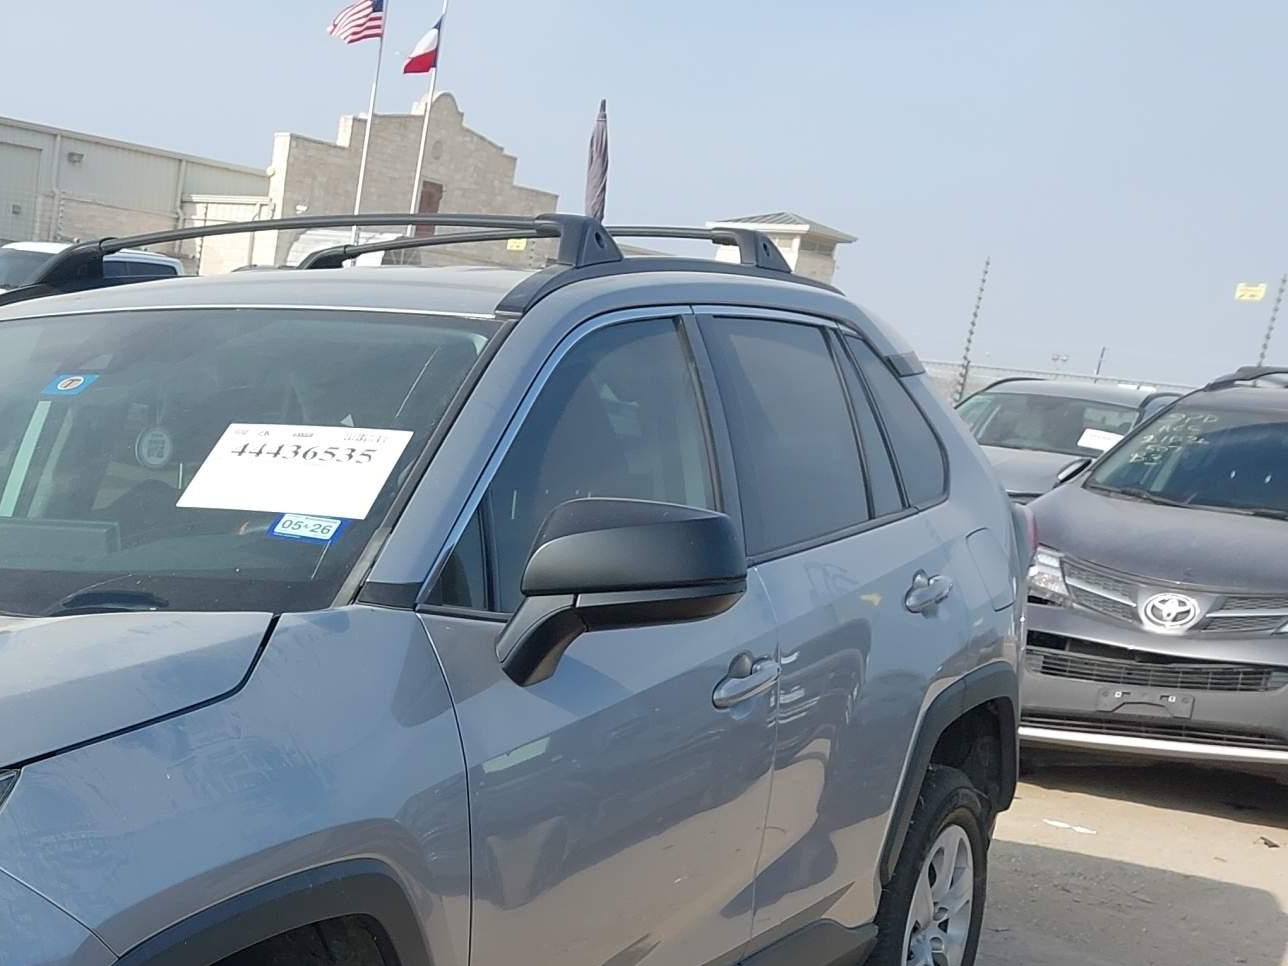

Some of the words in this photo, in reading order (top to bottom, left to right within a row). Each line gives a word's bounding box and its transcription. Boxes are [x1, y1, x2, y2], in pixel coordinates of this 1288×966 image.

[231, 442, 377, 464] 44436535
[281, 519, 304, 531] 05
[309, 523, 333, 535] 26
